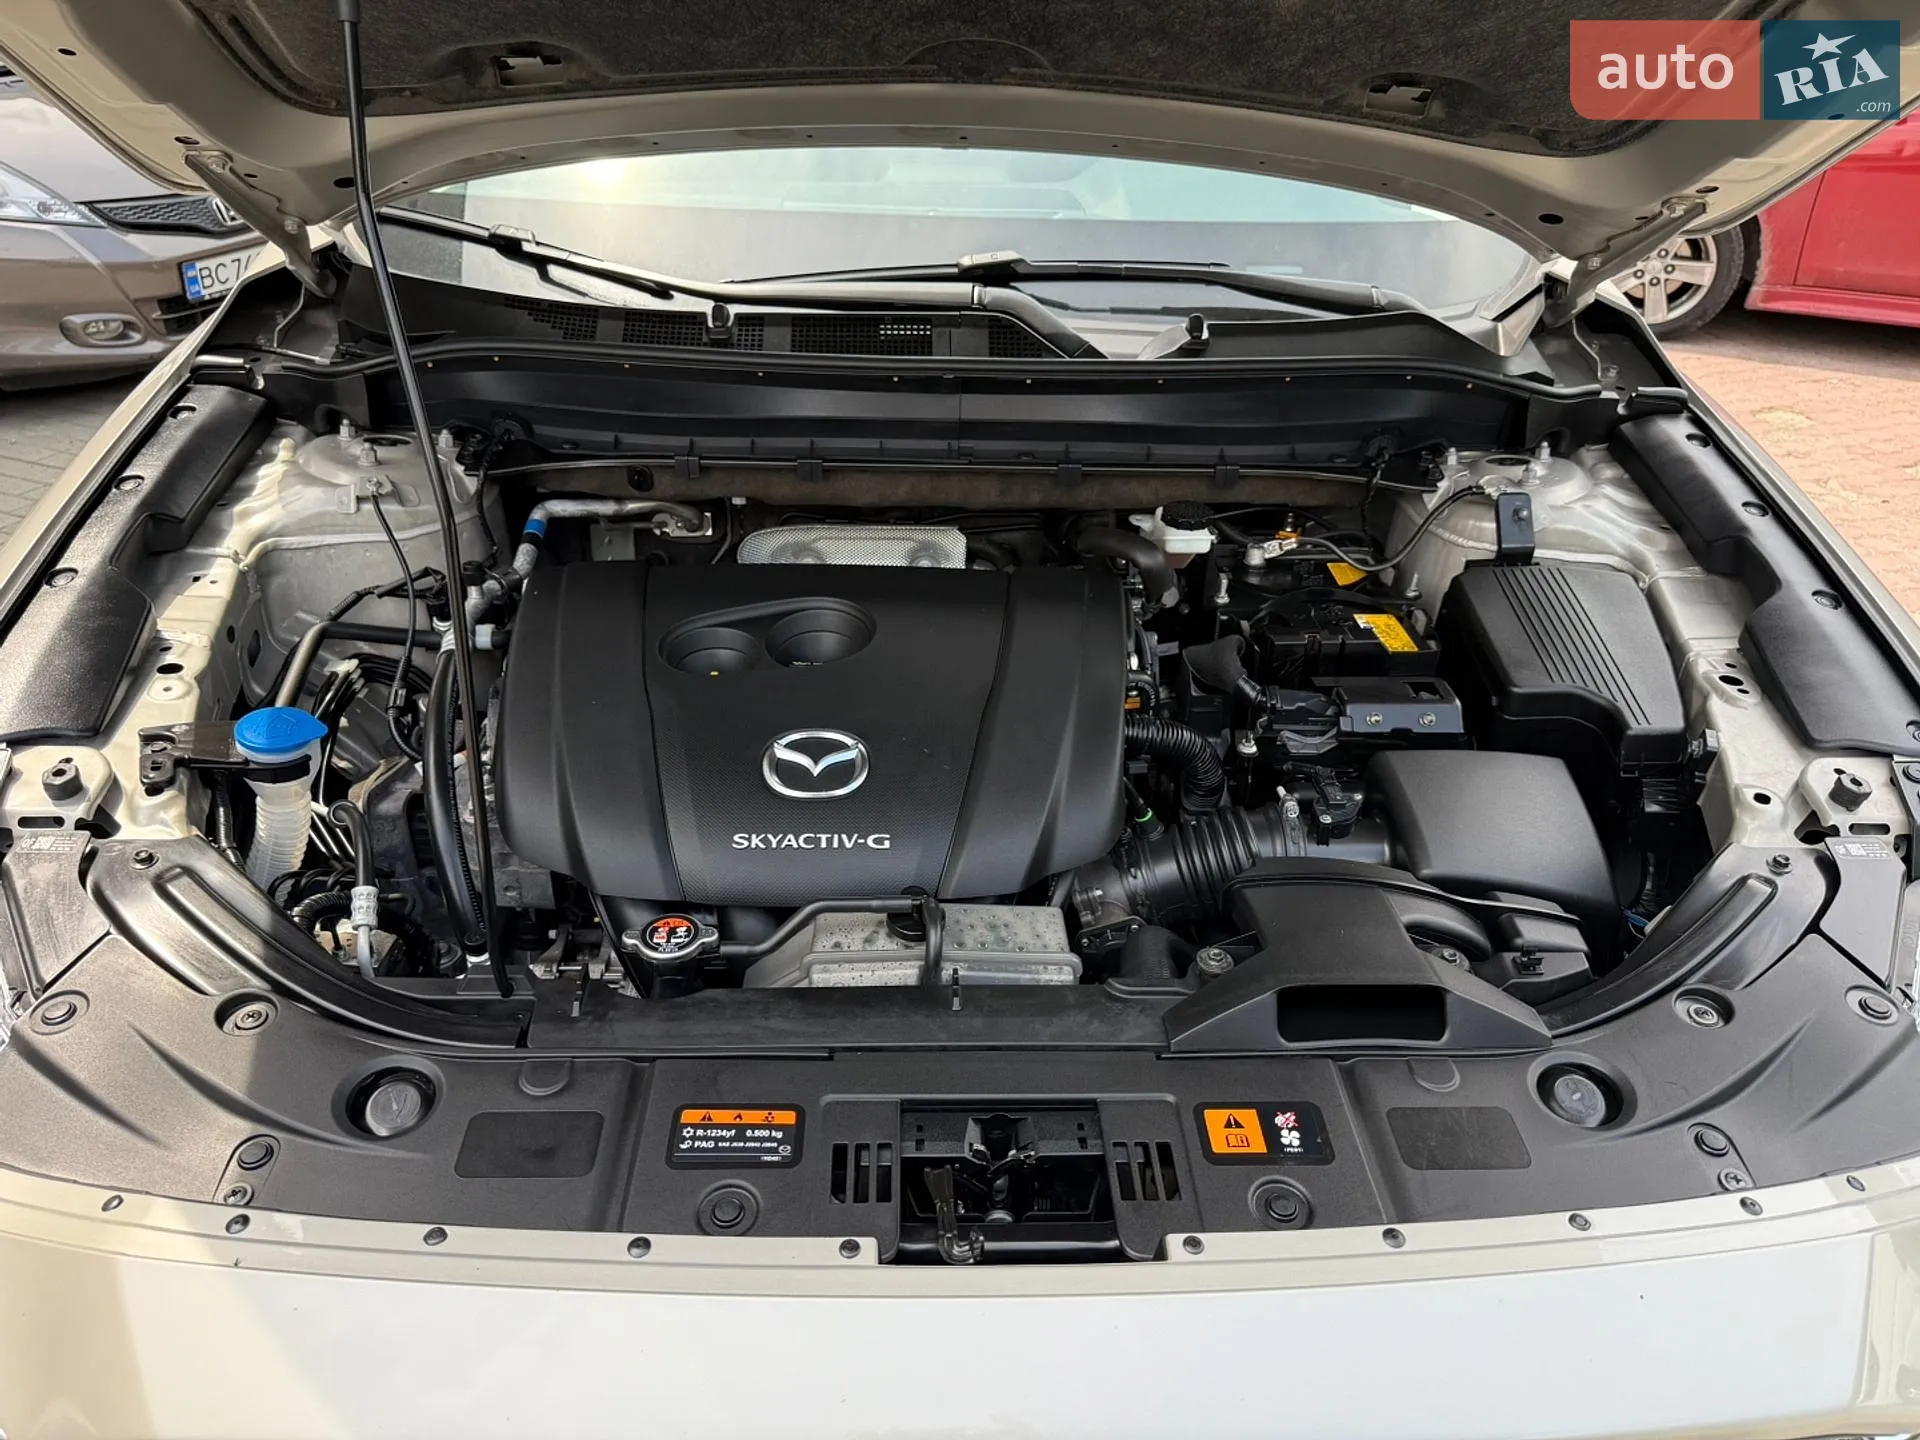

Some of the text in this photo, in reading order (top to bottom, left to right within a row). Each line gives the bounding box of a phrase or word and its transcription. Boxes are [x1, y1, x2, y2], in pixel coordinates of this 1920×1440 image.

[199, 251, 260, 289] BC7
[731, 833, 891, 849] SKYACTIV-G
[770, 1129, 783, 1138] kg
